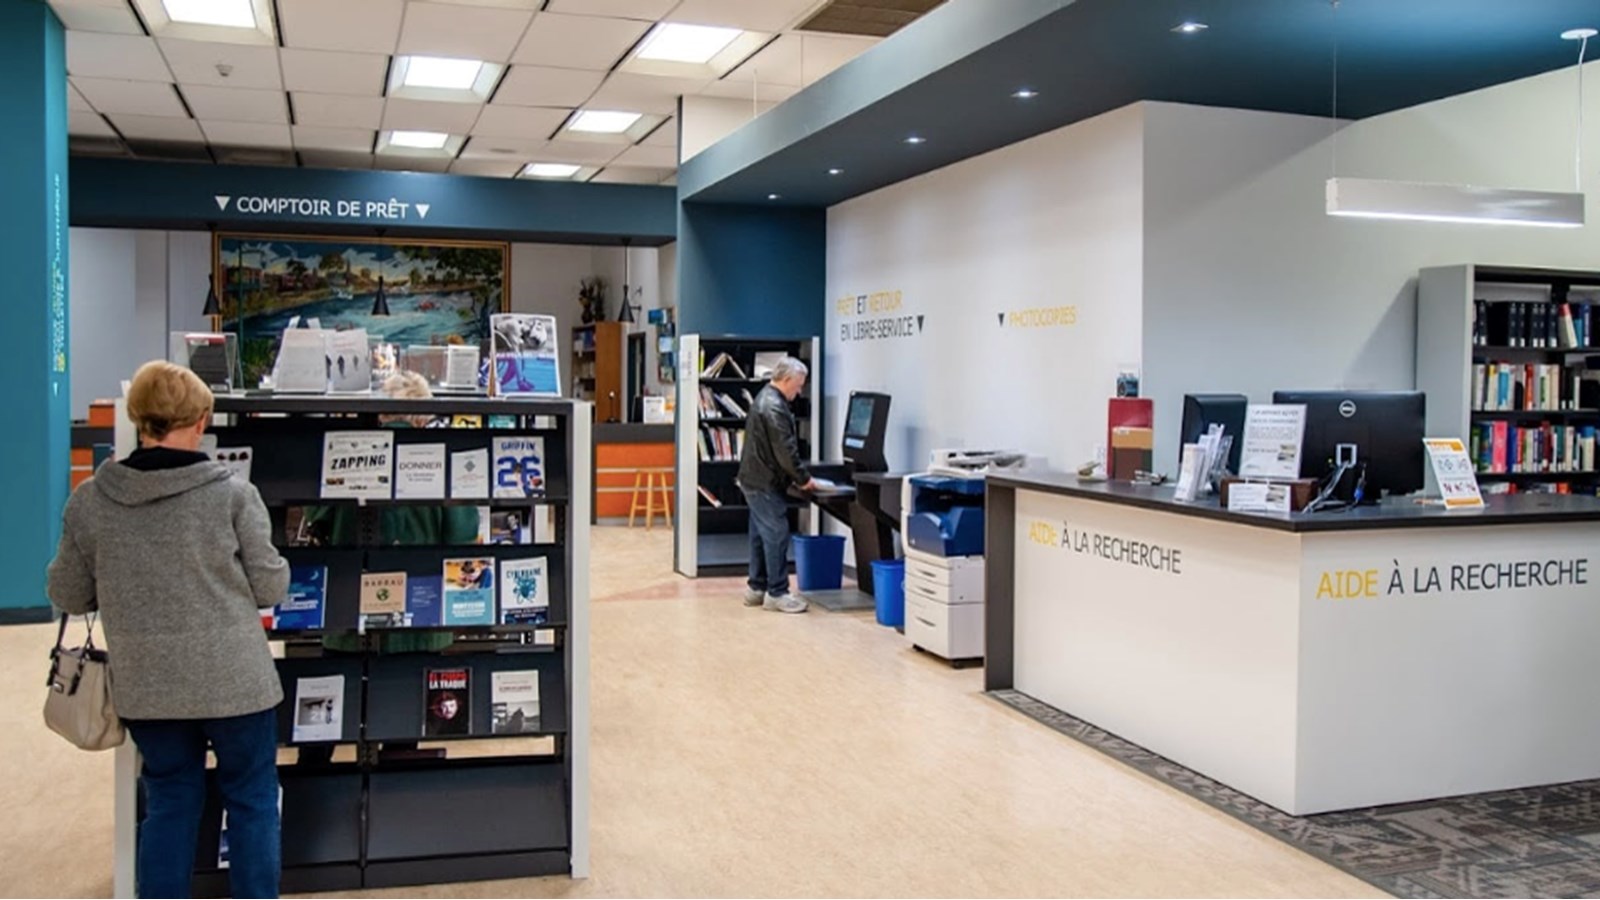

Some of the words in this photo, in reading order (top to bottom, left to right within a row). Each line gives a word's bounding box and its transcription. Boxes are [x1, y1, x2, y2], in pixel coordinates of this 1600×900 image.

[237, 197, 332, 216] COMPTOIR
[337, 201, 361, 217] DE
[366, 198, 409, 219] PRÊT
[837, 295, 855, 315] PRÊT
[857, 295, 868, 315] ET
[869, 291, 902, 313] RETOUR
[1009, 306, 1077, 327] PHOTOCOPIES
[840, 323, 852, 342] EN
[853, 315, 914, 340] LIBRE-SERVICE
[331, 455, 387, 471] ZAPPING
[399, 462, 442, 471] DONNER
[1028, 520, 1058, 549] AIDE
[1061, 520, 1071, 550] À
[1074, 530, 1090, 553] LA
[1094, 533, 1182, 575] RECHERCHE
[1316, 568, 1379, 600] AIDE
[1387, 559, 1405, 595] À
[1413, 566, 1442, 594] LA
[1451, 558, 1589, 592] RECHERCHE
